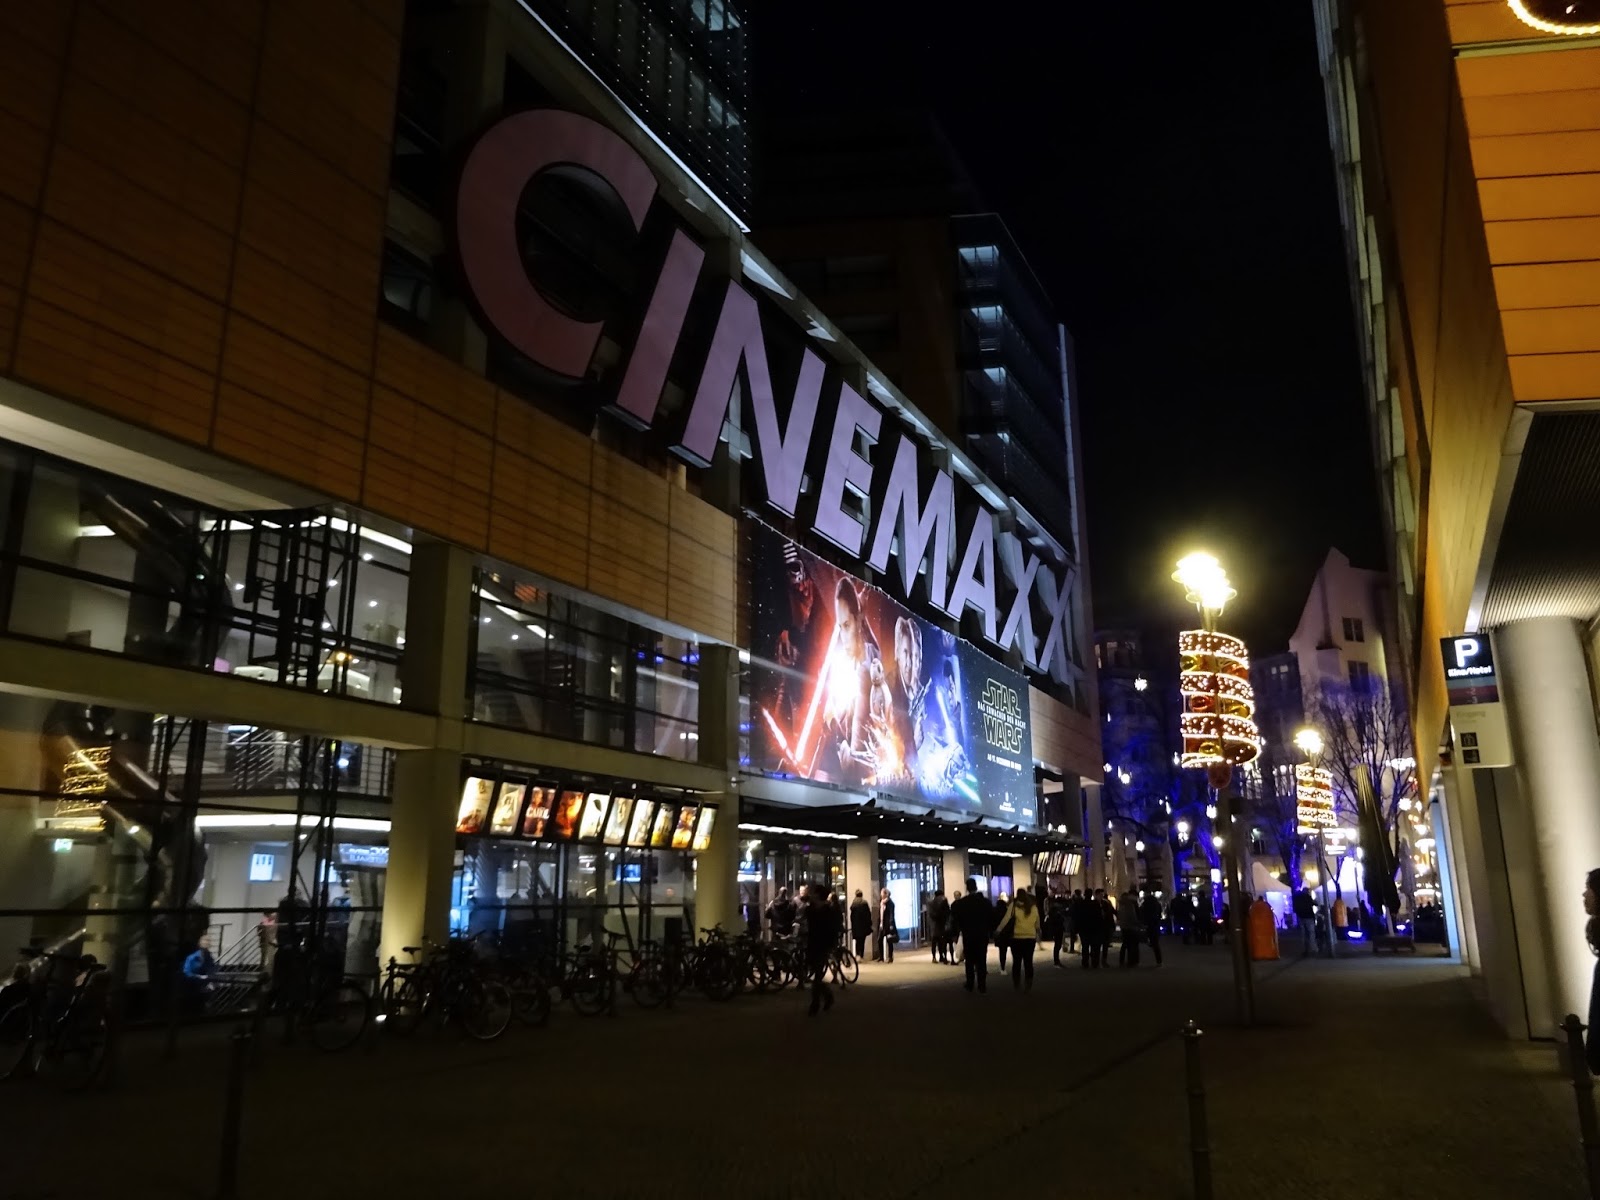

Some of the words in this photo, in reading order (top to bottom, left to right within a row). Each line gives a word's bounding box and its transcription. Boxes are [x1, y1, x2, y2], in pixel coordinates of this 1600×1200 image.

[456, 107, 1076, 686] CINEMAXX
[1454, 638, 1479, 668] P
[982, 677, 1022, 719] STAR
[983, 712, 1023, 755] WARS
